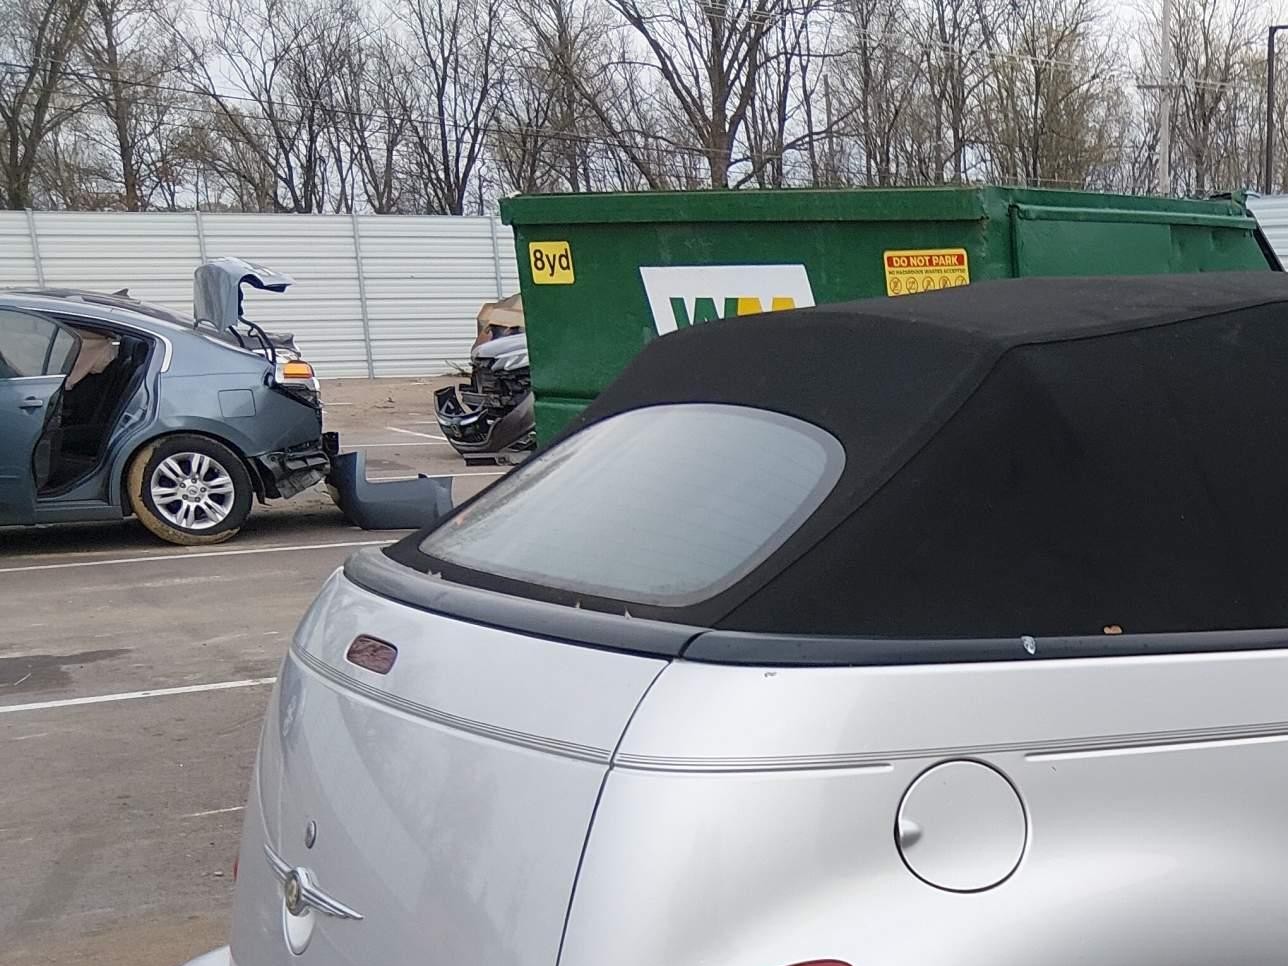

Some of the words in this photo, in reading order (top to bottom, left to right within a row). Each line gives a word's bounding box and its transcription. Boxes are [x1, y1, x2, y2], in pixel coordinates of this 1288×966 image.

[533, 248, 570, 277] 8yd
[893, 257, 908, 267] DO
[910, 256, 931, 267] NOT
[932, 255, 959, 266] PARK
